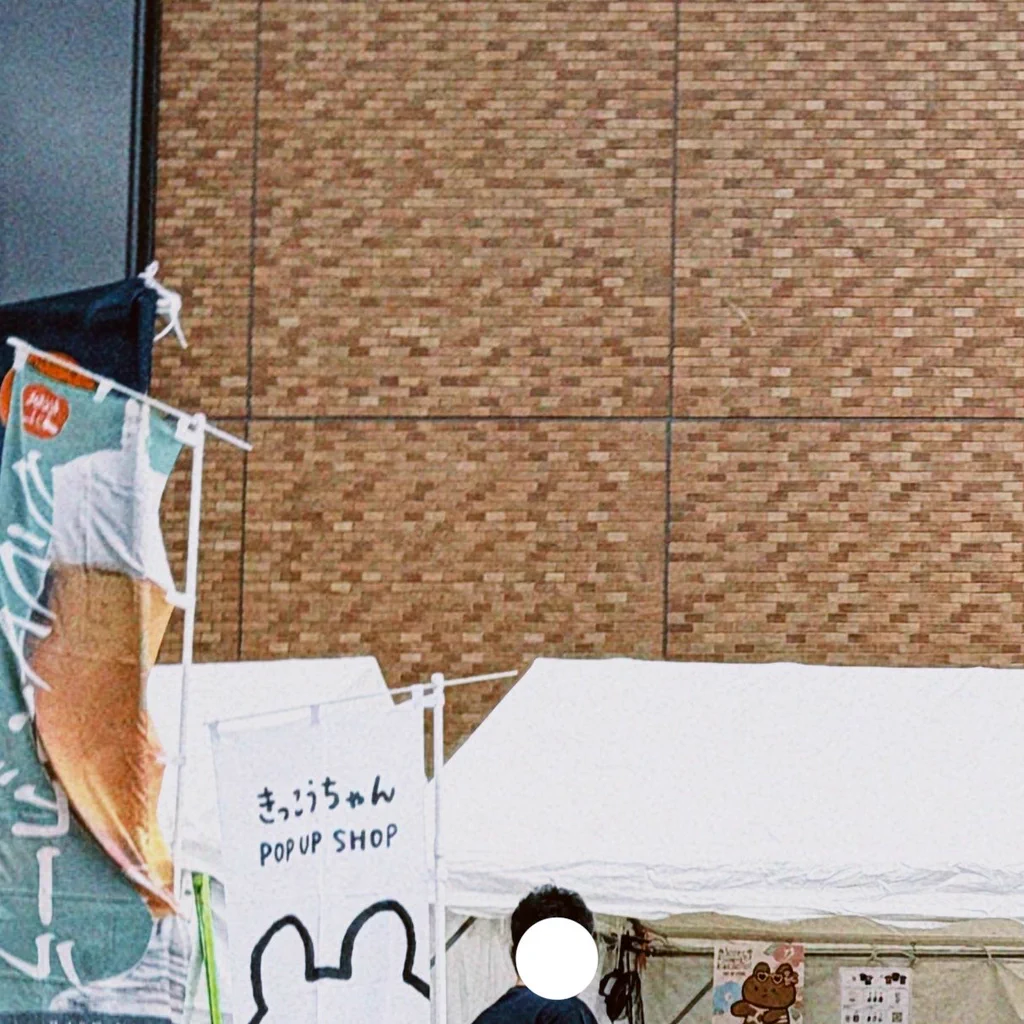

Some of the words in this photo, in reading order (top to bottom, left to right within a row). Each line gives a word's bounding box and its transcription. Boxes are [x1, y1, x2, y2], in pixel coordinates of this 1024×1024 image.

[257, 775, 396, 824] きっこうちゃん
[333, 823, 398, 853] SHOP
